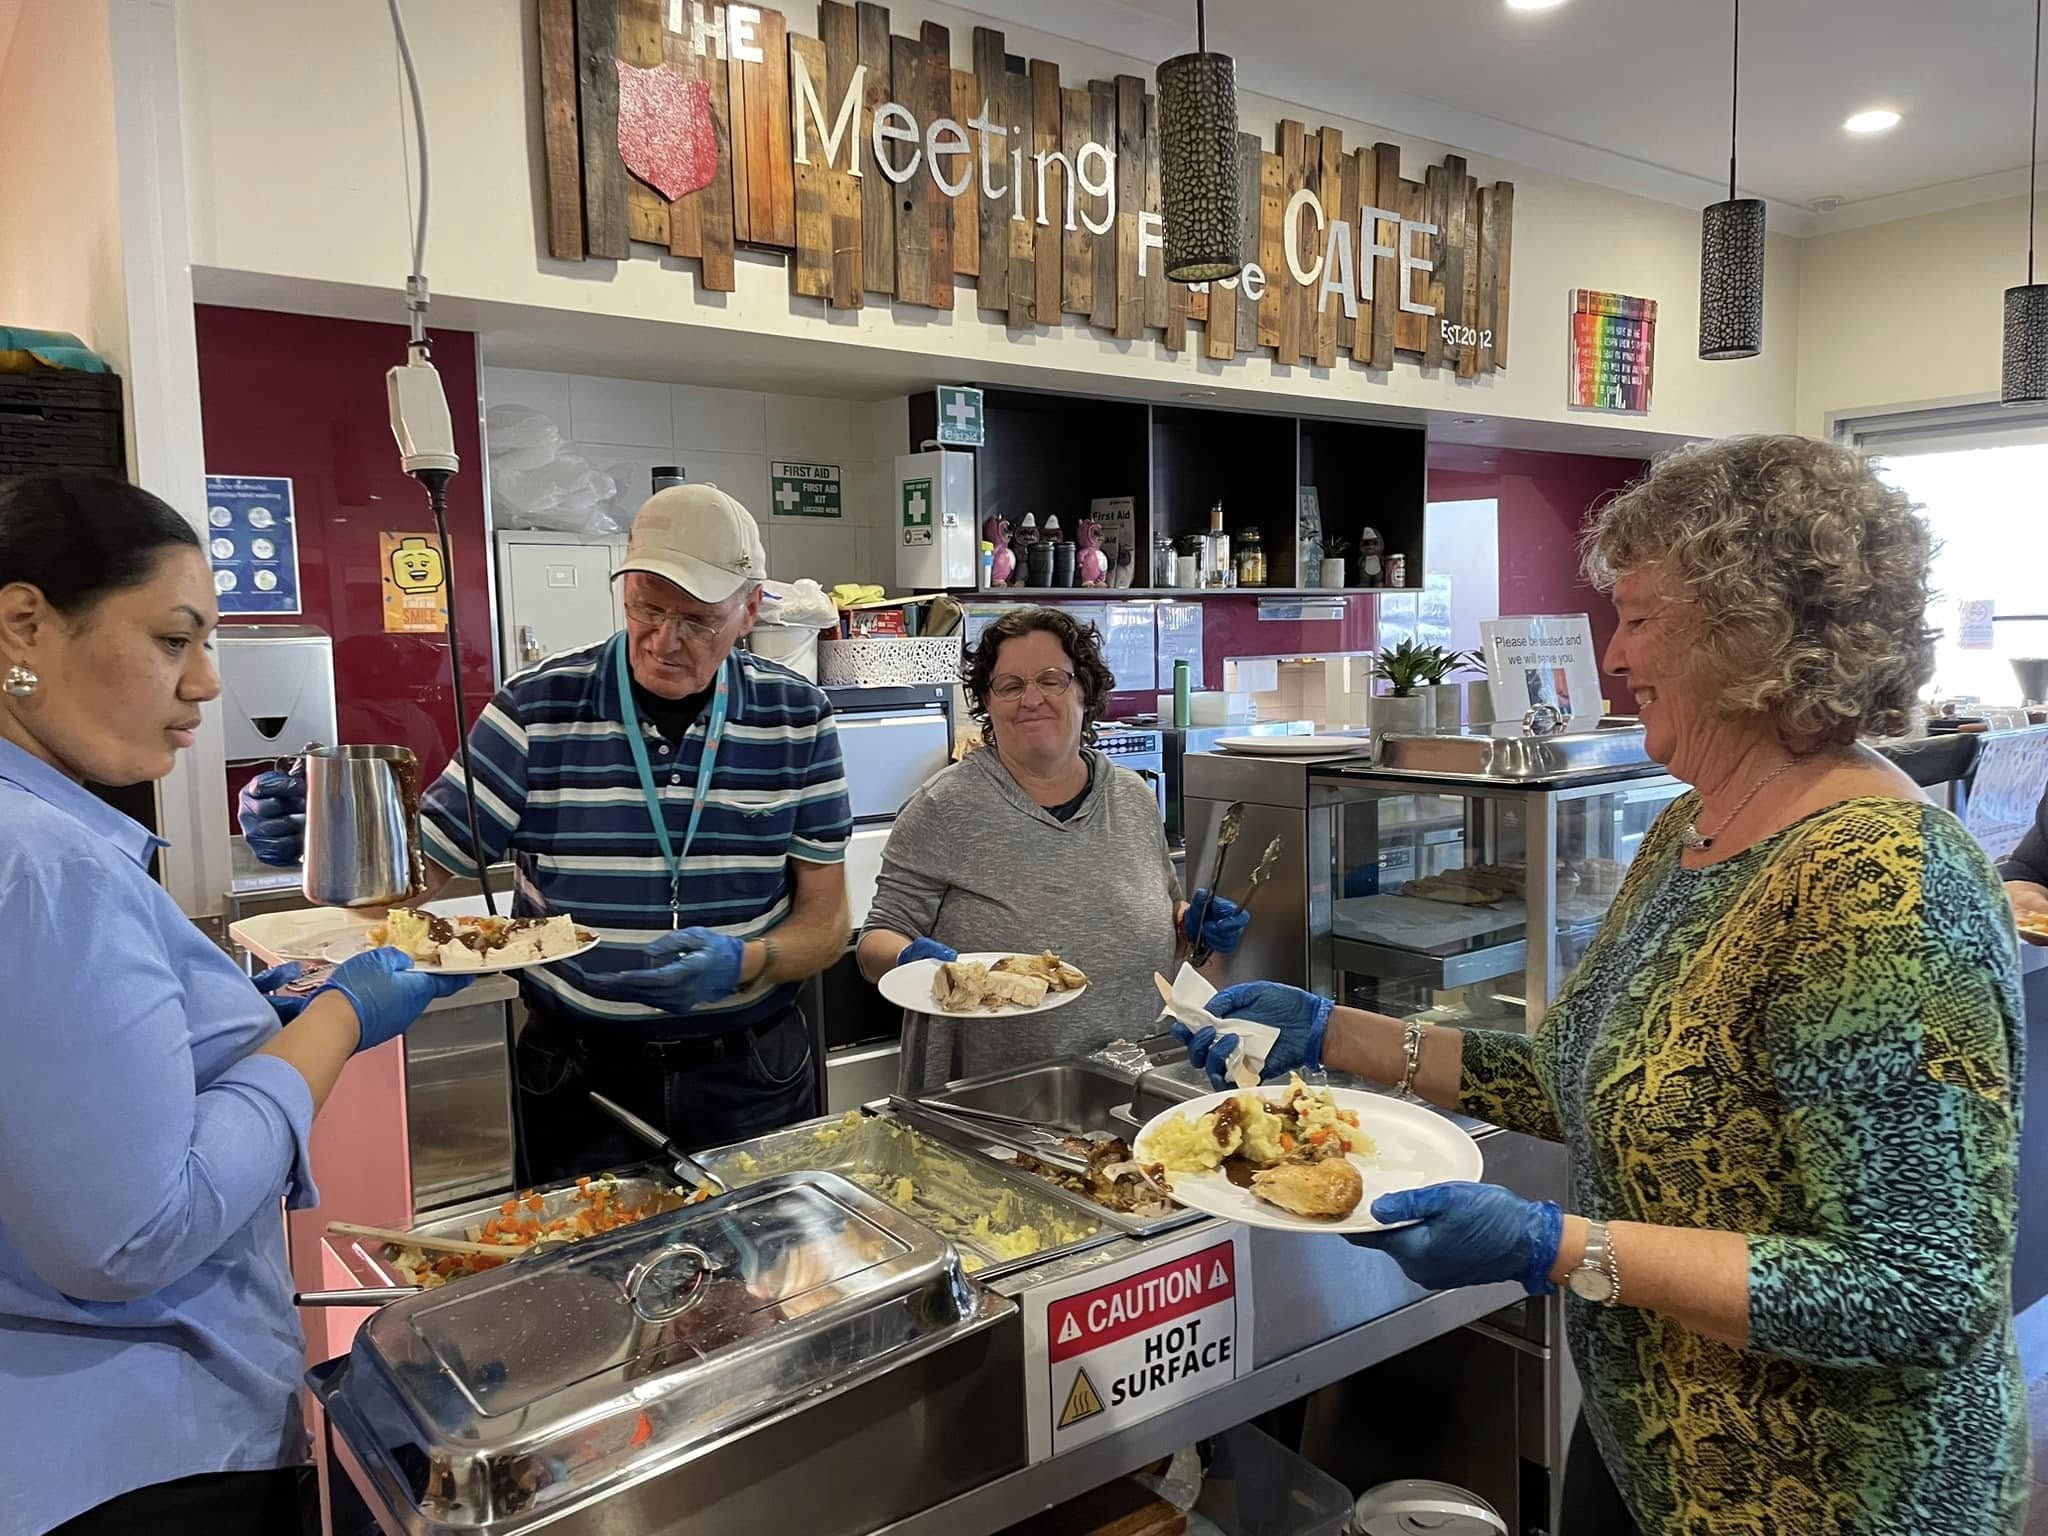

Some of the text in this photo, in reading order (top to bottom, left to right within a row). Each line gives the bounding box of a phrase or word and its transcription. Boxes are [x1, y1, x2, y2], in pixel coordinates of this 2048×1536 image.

[790, 50, 1117, 235] Meeting
[1284, 188, 1439, 319] CAFE
[783, 465, 830, 479] FIRST AID
[802, 482, 838, 494] FIRST AID
[814, 495, 826, 504] KIT
[1092, 509, 1130, 521] First Aid
[402, 608, 437, 624] SMILE
[1495, 634, 1582, 648] Please be seated and
[1507, 655, 1522, 665] we
[1523, 652, 1536, 664] will
[1087, 1263, 1202, 1333] CAUTION
[1144, 1319, 1201, 1364] HOT
[1111, 1336, 1231, 1406] SURFACE
